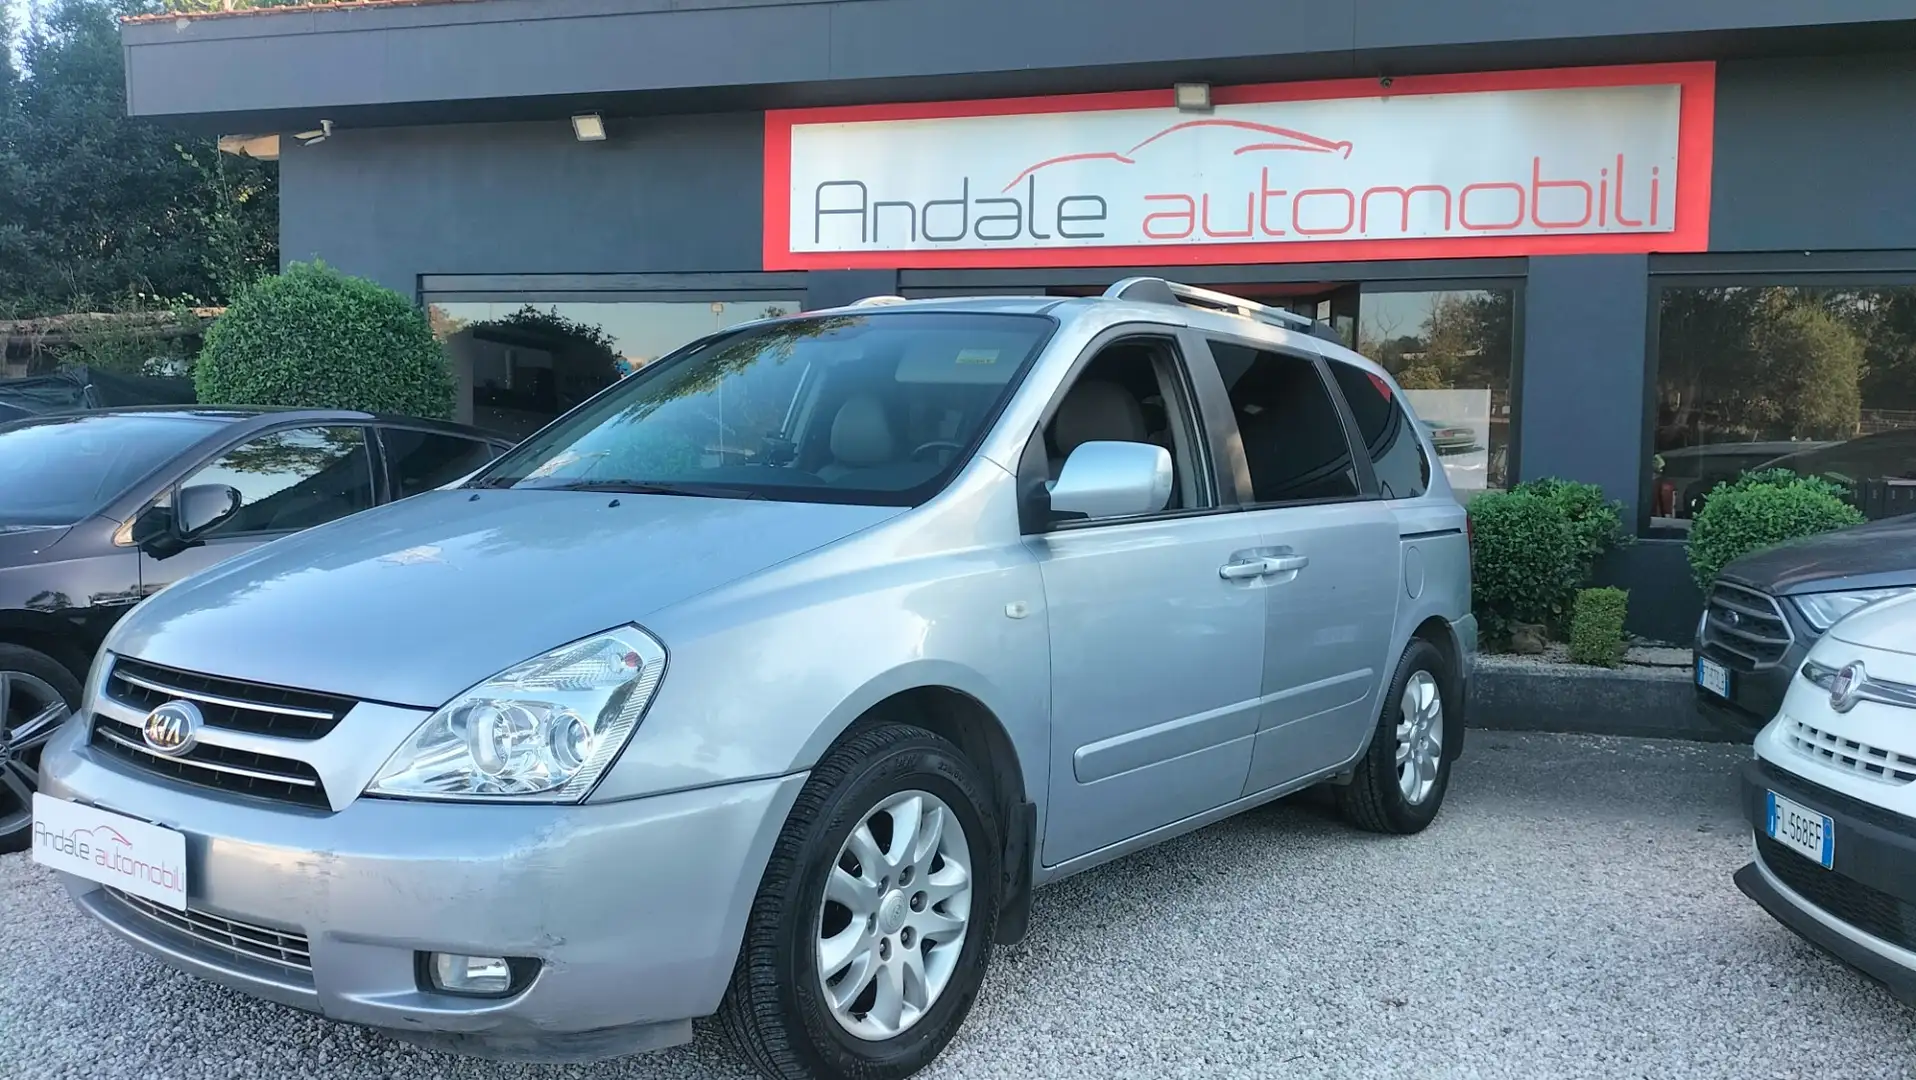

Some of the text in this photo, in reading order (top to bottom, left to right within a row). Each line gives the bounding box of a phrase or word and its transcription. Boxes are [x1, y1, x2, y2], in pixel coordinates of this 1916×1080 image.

[814, 153, 1660, 244] Andale automobili
[149, 713, 182, 744] KIA
[34, 821, 185, 893] Andale automobili
